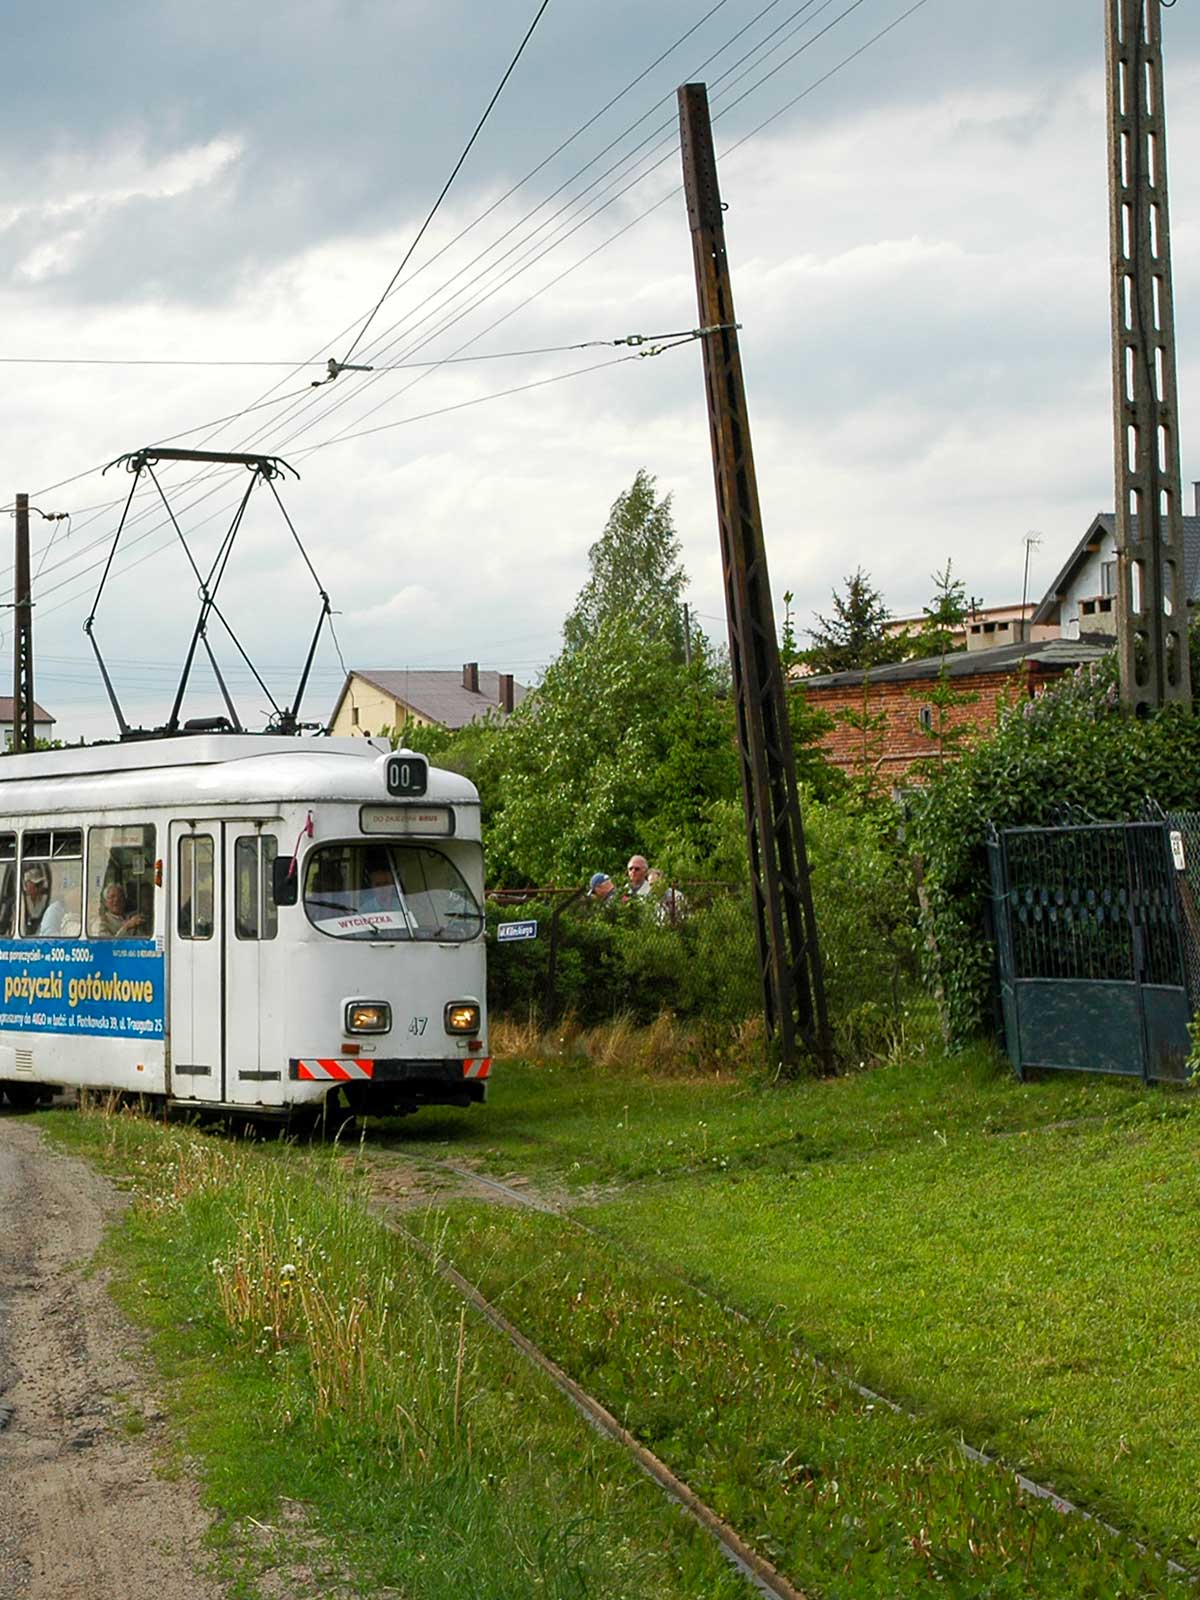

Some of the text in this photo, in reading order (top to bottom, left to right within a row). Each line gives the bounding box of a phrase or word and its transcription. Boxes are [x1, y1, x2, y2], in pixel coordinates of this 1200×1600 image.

[338, 915, 393, 929] WYCIECZKA
[51, 948, 65, 962] 500
[71, 948, 89, 963] 5000
[4, 969, 154, 1007] pożyczki gotówkowe
[24, 1012, 31, 1024] do
